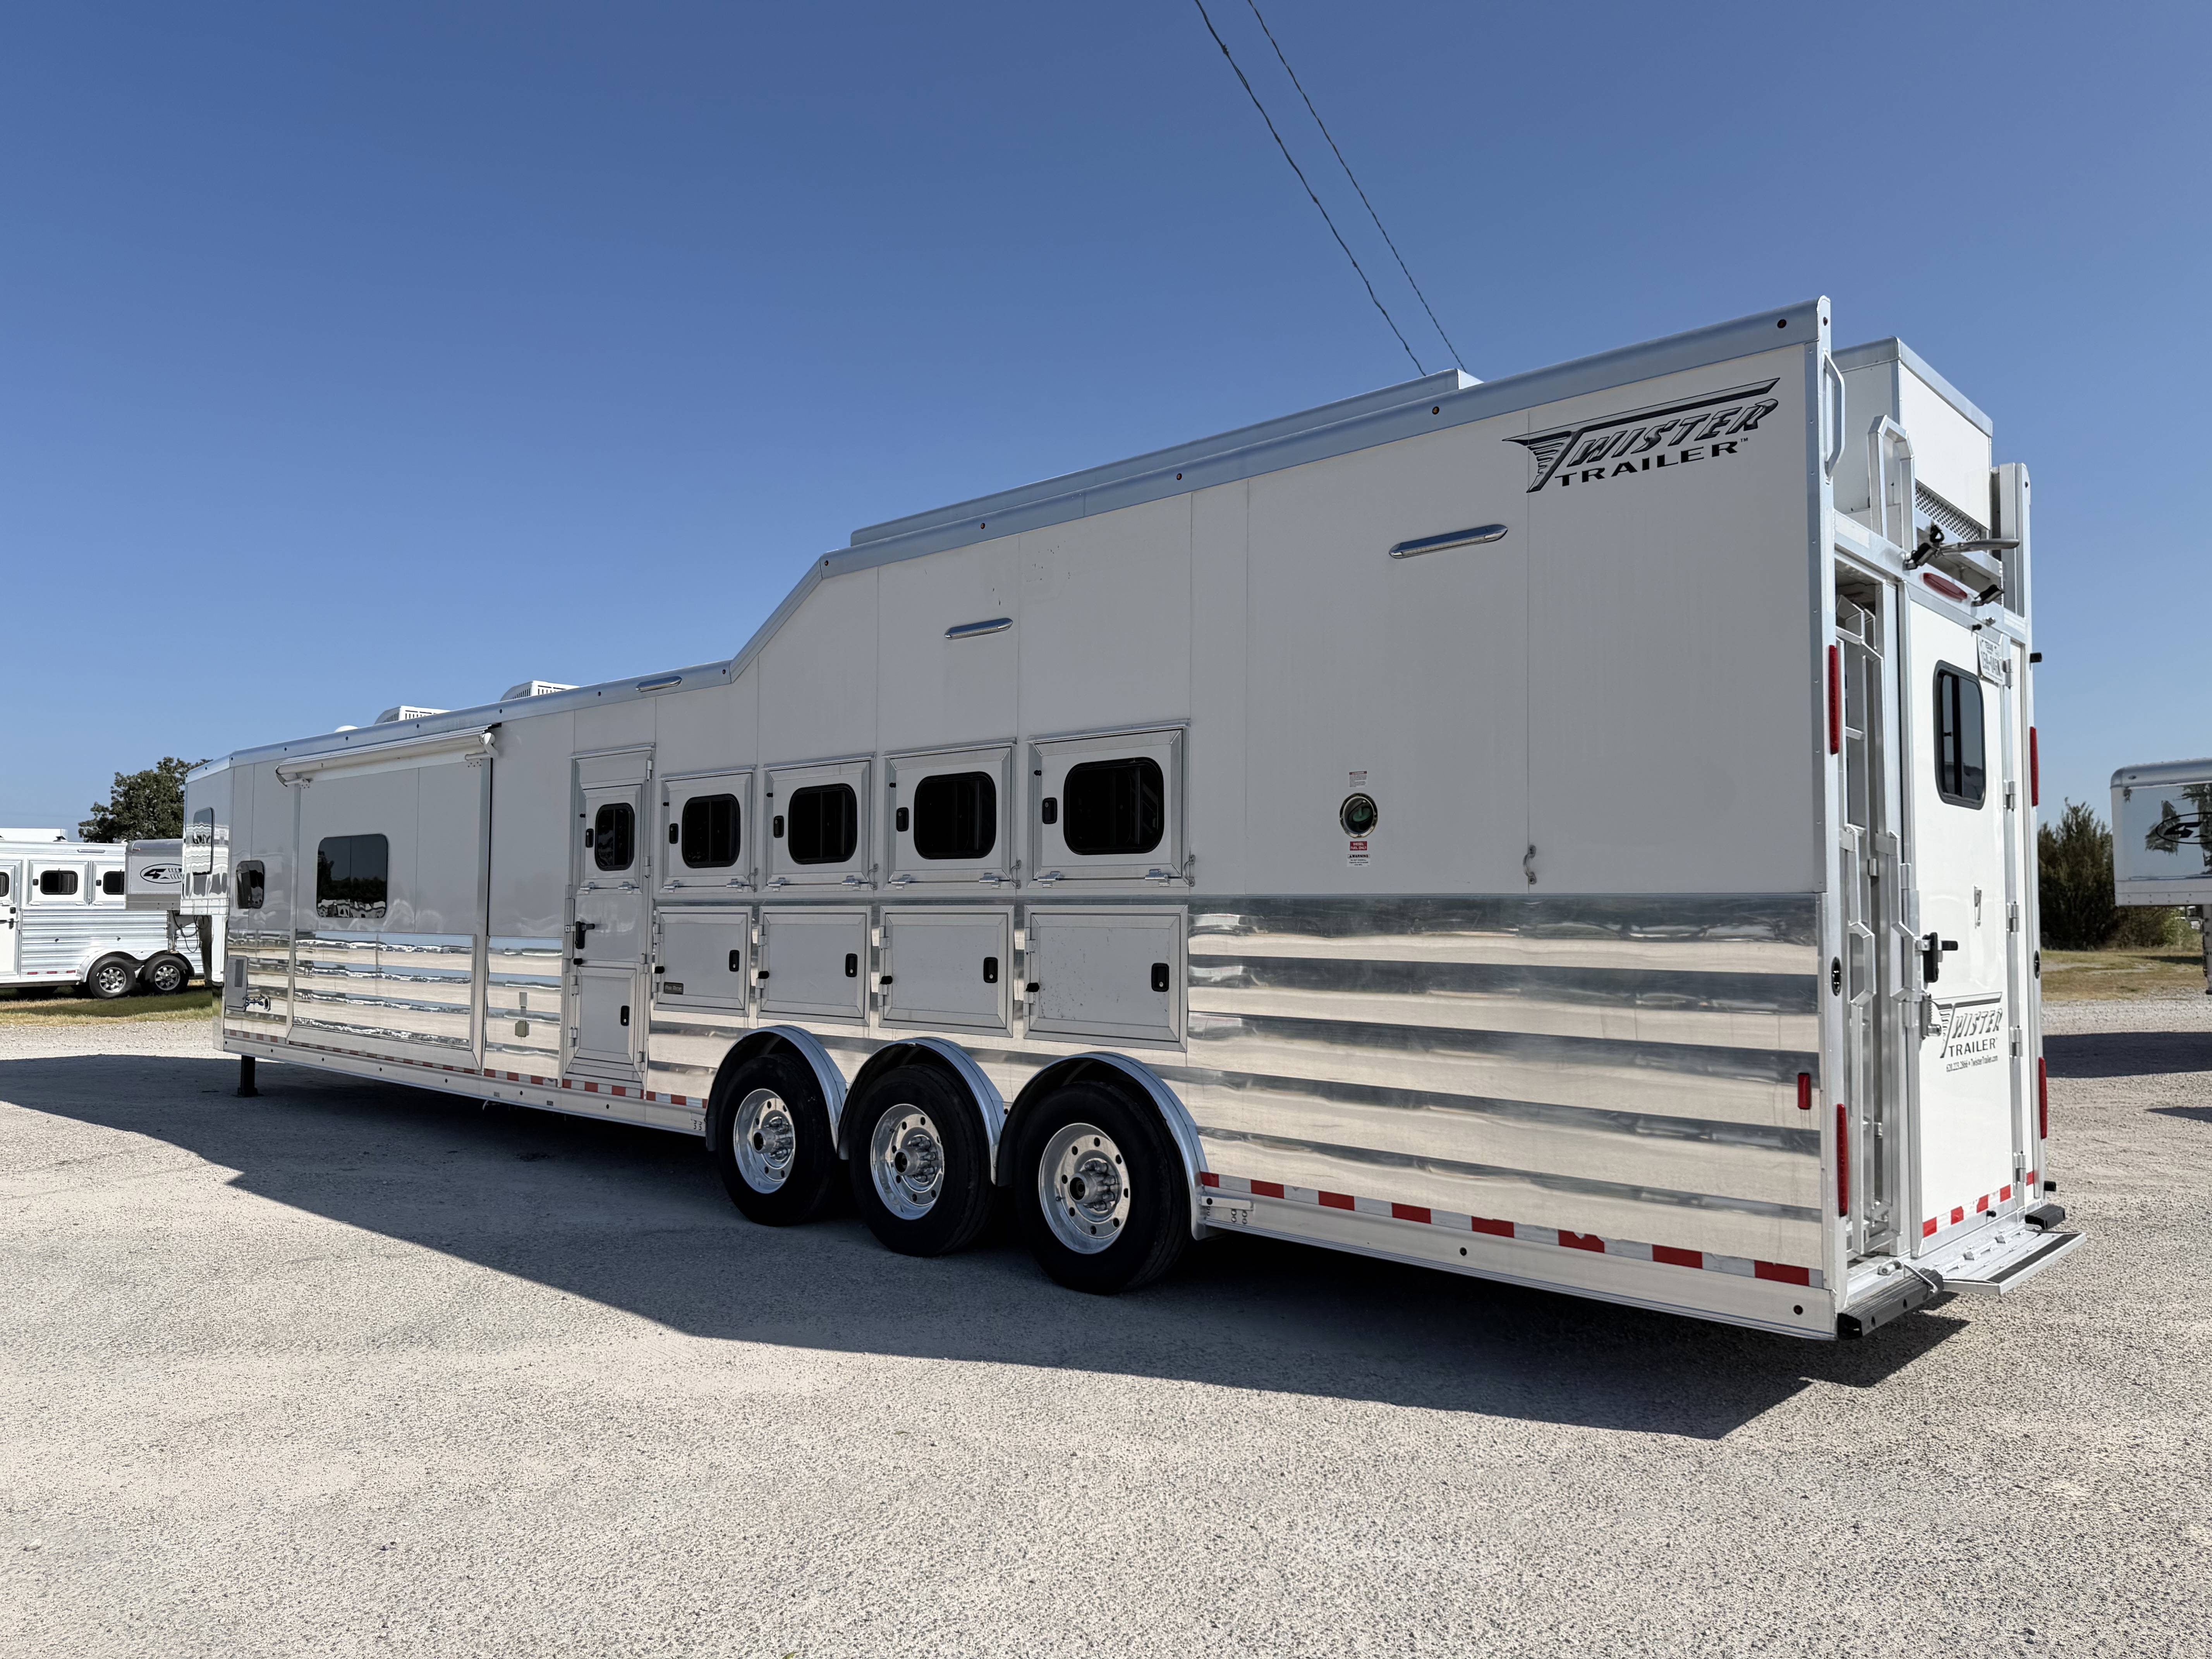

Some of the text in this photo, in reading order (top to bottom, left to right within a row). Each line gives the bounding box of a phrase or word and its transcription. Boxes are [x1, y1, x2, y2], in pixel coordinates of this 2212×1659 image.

[1501, 377, 1781, 493] TWISTER
[1554, 441, 1738, 487] TRAILER
[1930, 991, 2002, 1058] TWISTER
[1948, 1038, 1996, 1057] TRAILER
